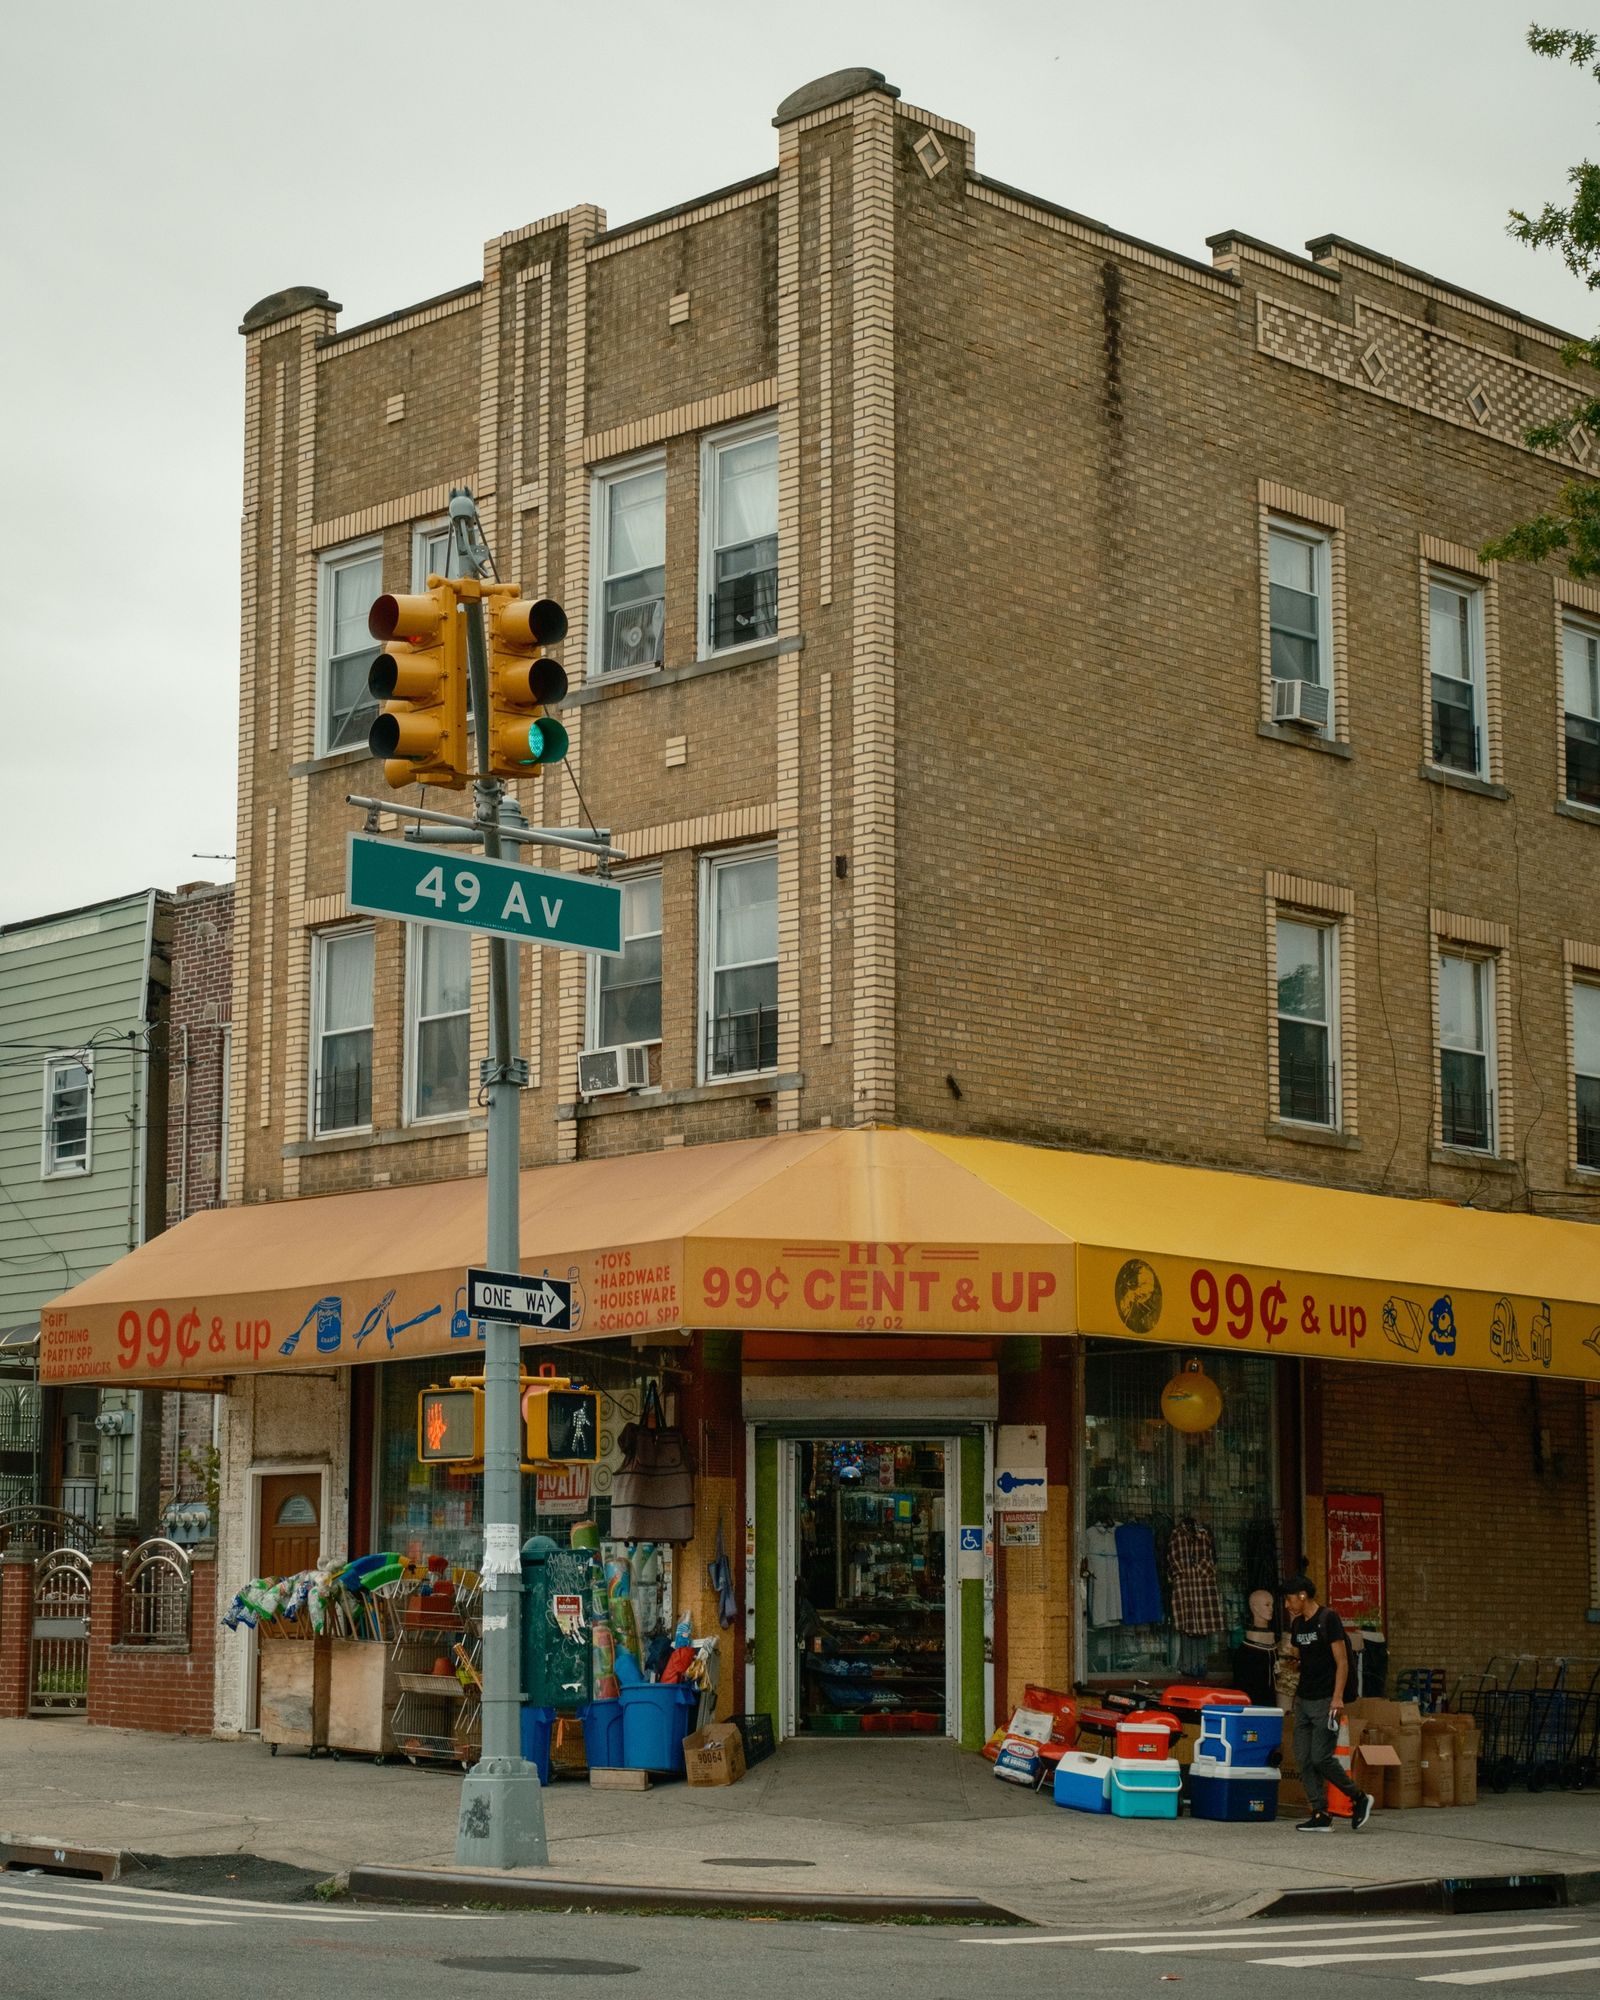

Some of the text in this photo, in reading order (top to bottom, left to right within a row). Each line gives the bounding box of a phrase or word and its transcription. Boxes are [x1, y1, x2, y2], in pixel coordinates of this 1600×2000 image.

[415, 866, 563, 929] 49 Av
[601, 1251, 632, 1269] TOYS
[848, 1242, 914, 1266] HY
[601, 1265, 671, 1288] HARDWARE
[482, 1286, 556, 1313] ONE WAY
[600, 1285, 677, 1310] HOUSEWARE
[702, 1266, 1057, 1313] 99¢ CENT & UP
[48, 1313, 68, 1327] GIFT
[600, 1305, 680, 1331] SCHOOL SPP
[1189, 1268, 1367, 1348] 99¢ & up
[855, 1316, 904, 1330] 49 02
[47, 1328, 89, 1346] CLOTHING
[117, 1306, 271, 1370] 99¢ & up
[48, 1346, 93, 1362] PARTY SPP
[46, 1361, 112, 1378] HAIR PRODUCTS
[557, 1464, 587, 1496] ATM
